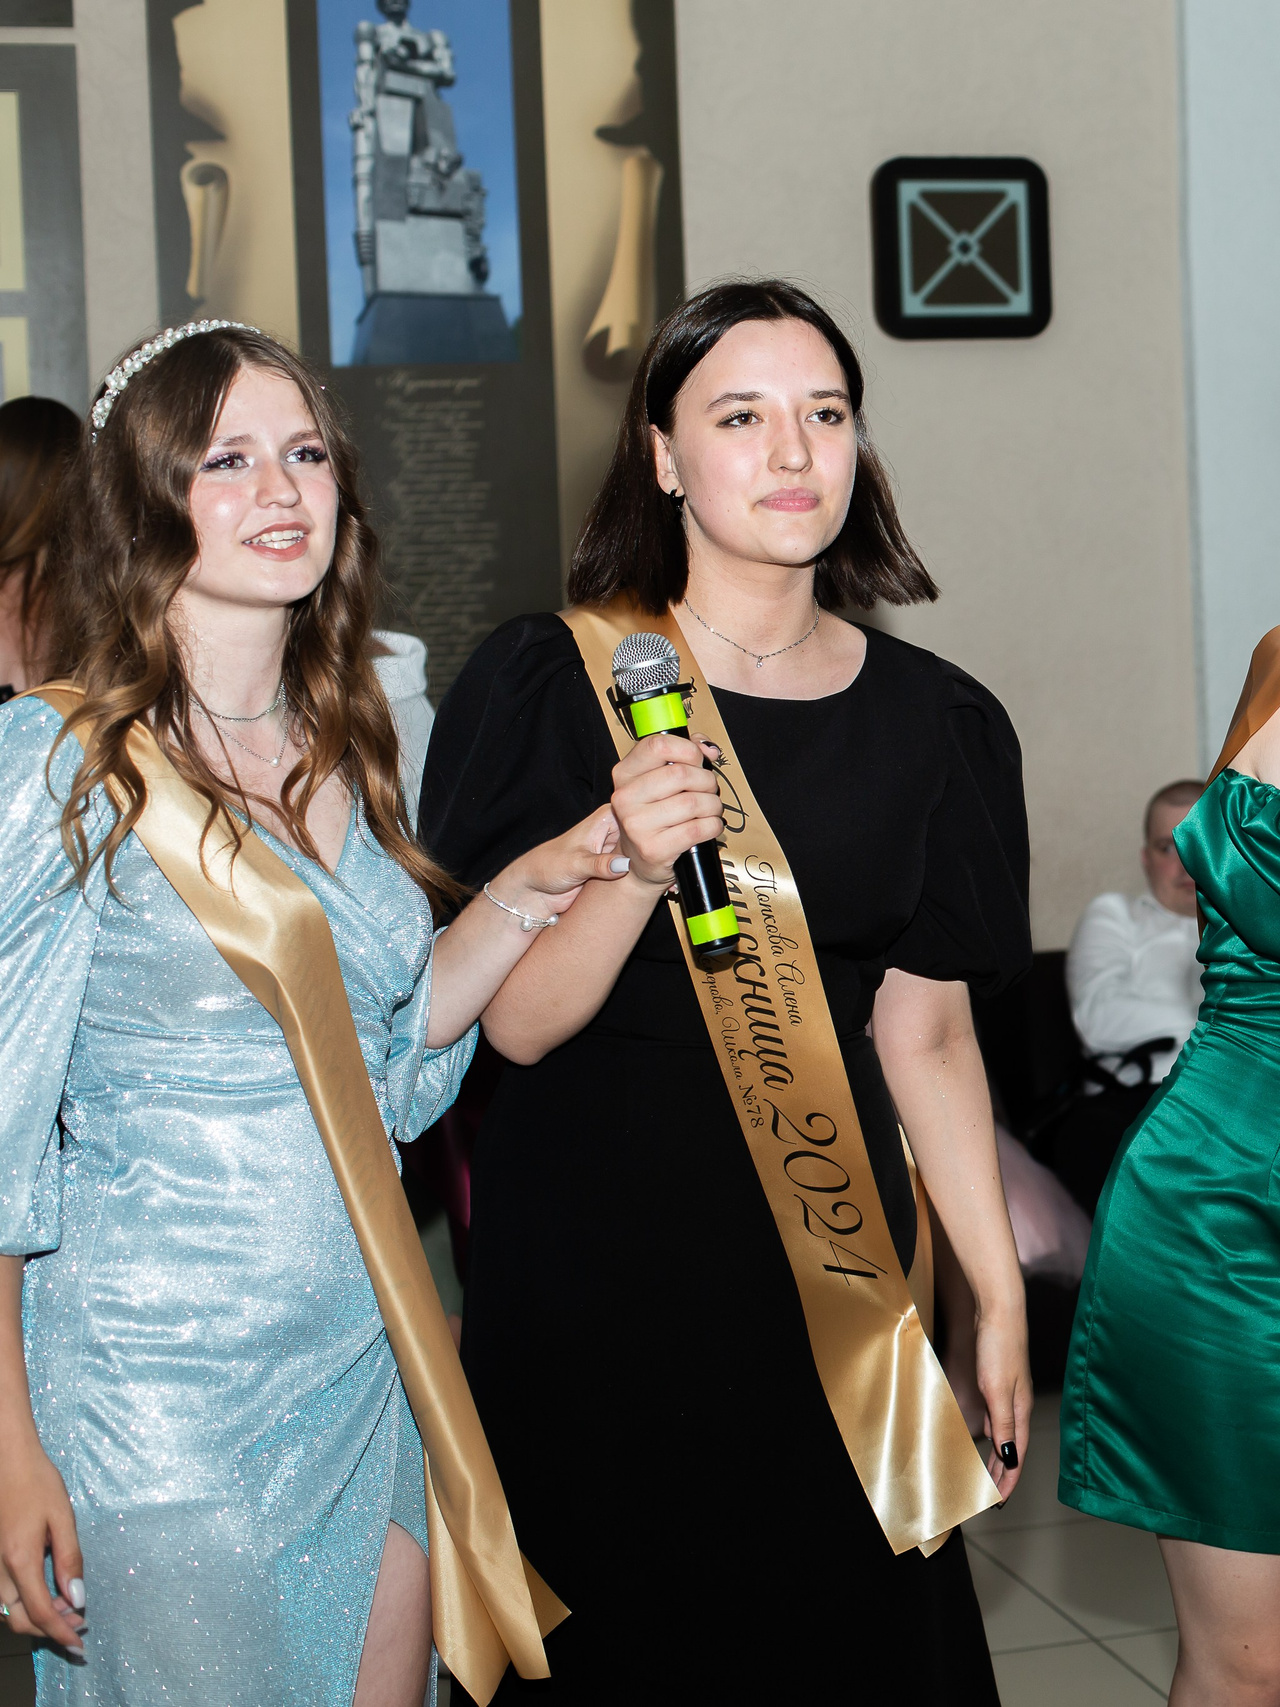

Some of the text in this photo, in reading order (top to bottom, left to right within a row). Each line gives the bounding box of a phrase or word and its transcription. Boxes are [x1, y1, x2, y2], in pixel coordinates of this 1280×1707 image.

[744, 854, 806, 1028] Попкова Алена
[721, 1016, 743, 1080] Школа
[763, 1098, 888, 1287] 2024
